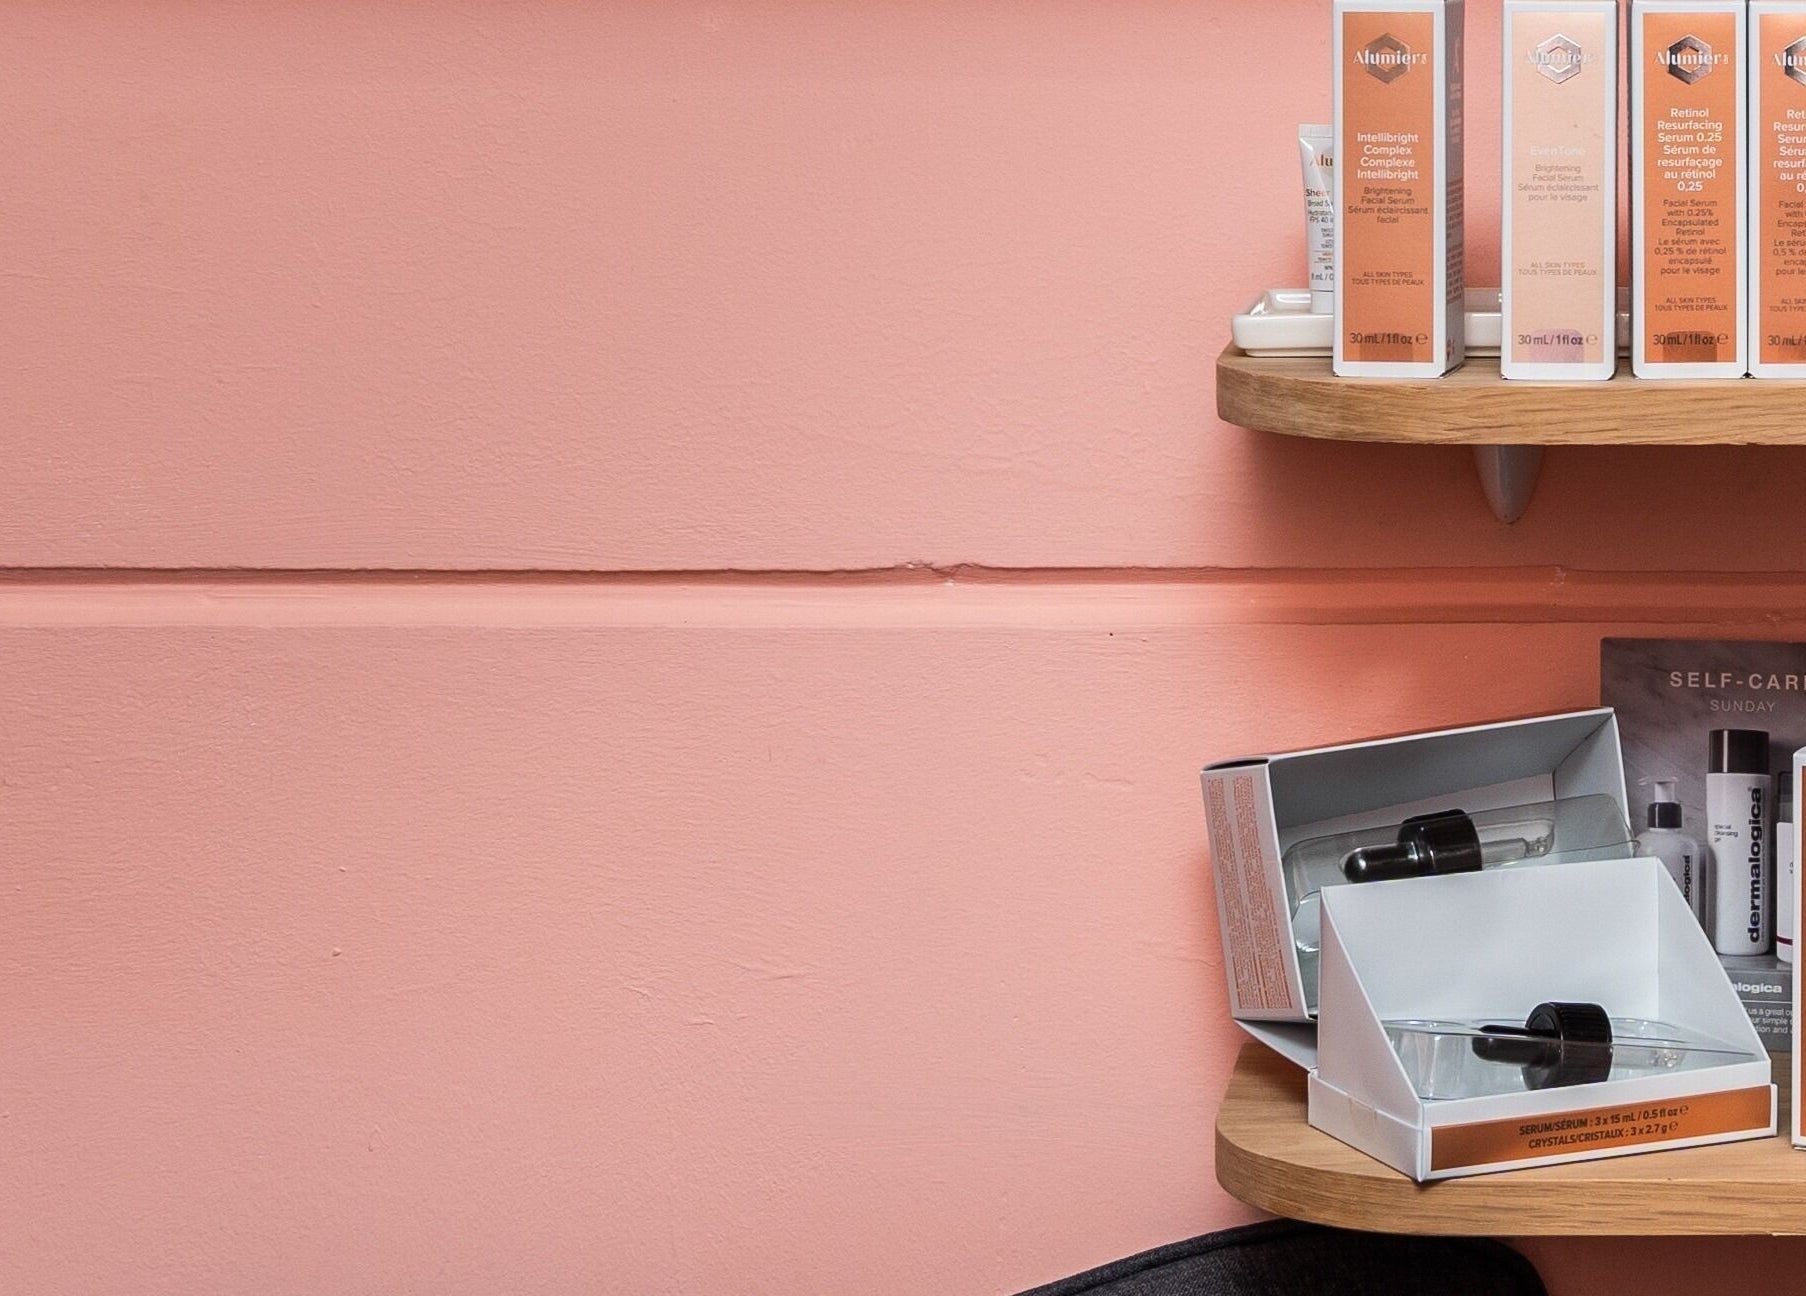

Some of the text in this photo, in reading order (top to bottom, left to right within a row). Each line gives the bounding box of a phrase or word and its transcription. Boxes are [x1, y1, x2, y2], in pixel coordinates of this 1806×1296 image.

[1357, 133, 1419, 145] Intellibright
[1363, 145, 1412, 156] Complex
[1360, 157, 1415, 168] Complexe
[1357, 169, 1419, 181] Intellibright
[1710, 700, 1775, 713] SUNDAY
[1748, 787, 1761, 943] dermalogica
